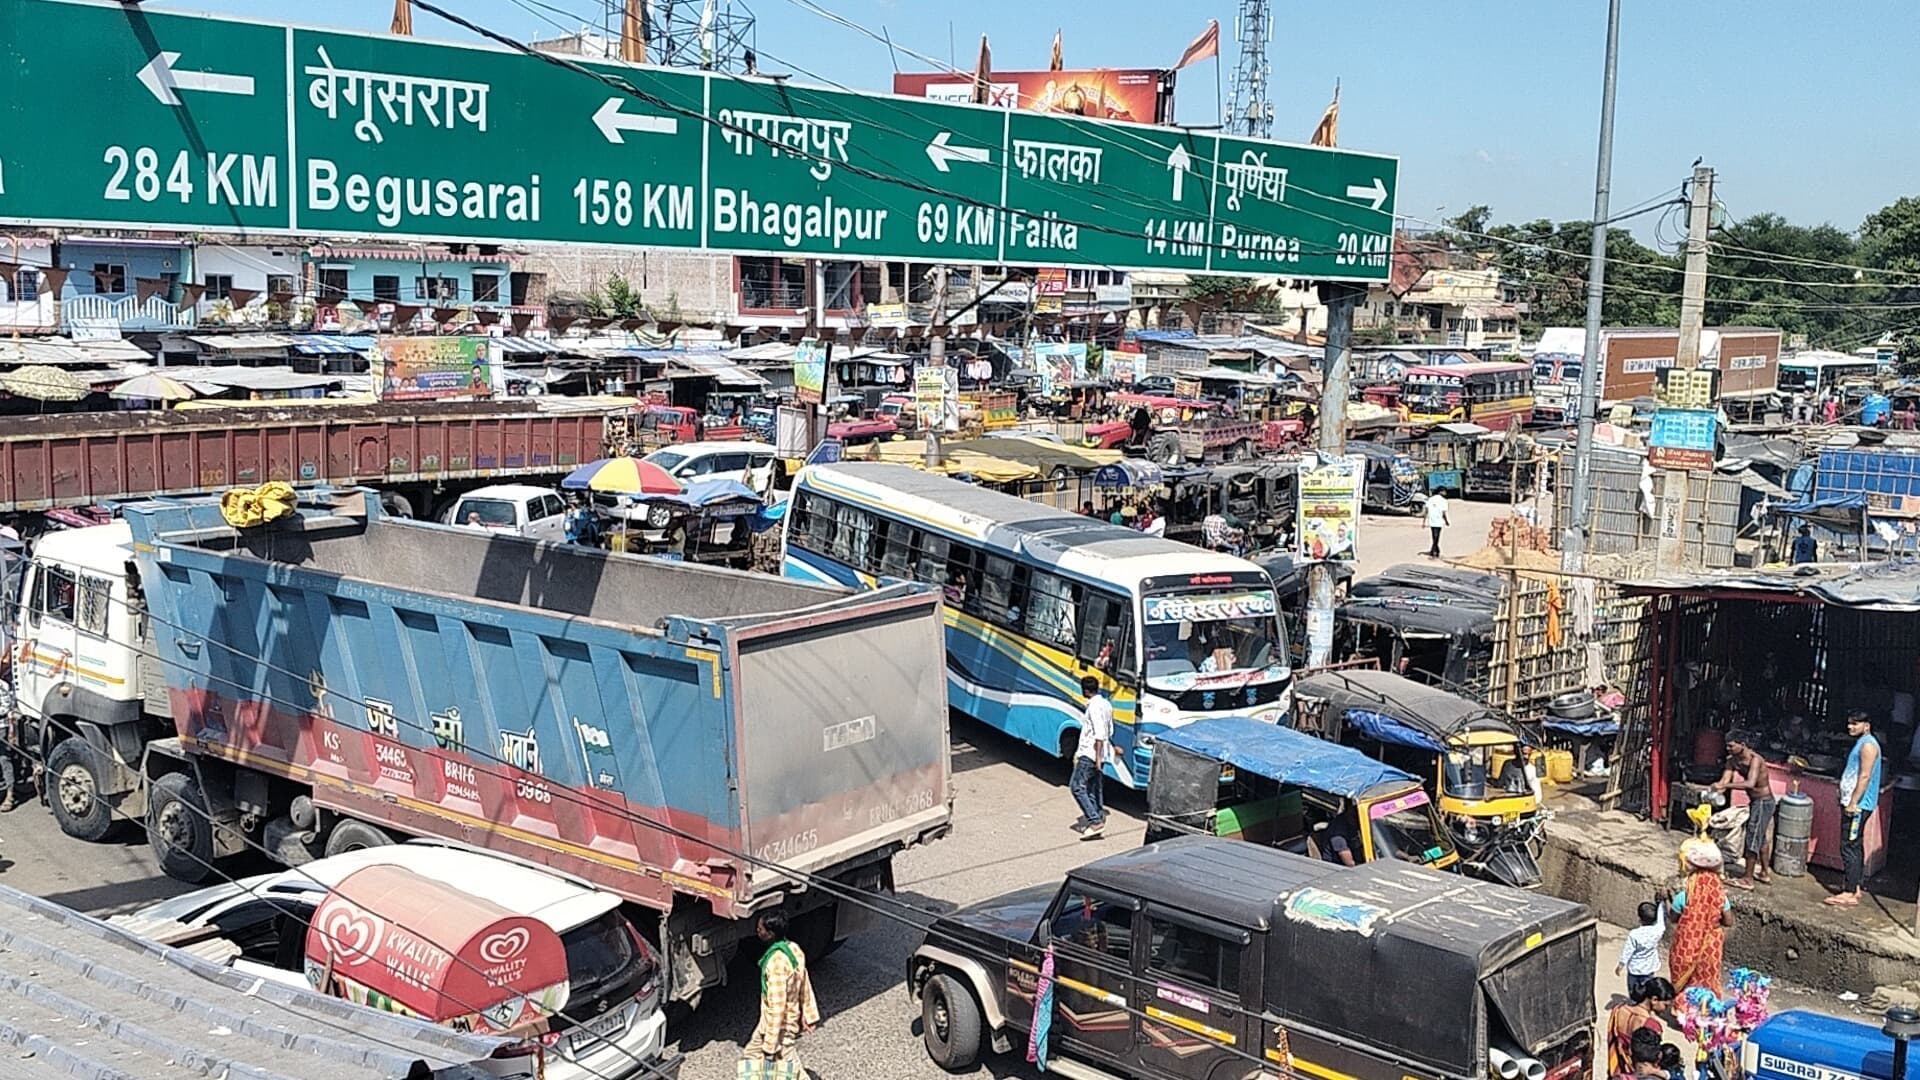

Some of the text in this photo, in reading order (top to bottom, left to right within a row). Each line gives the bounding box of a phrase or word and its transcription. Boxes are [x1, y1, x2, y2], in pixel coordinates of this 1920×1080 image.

[305, 46, 489, 143] बेगूसराय
[719, 109, 851, 181] भागलपुर
[1013, 139, 1102, 185] फालका
[103, 146, 277, 207] 284 KM
[308, 159, 694, 231] Begusarai 158 KM
[1224, 149, 1288, 212] पूर्णिया
[714, 188, 994, 248] Bhagalpur 69 KM
[1010, 209, 1204, 257] Falka 14 KM
[1221, 227, 1387, 268] Purnea 20 KM
[386, 931, 450, 971] KWALITY
[386, 954, 433, 992] WALL'S
[484, 957, 527, 977] KWALITY
